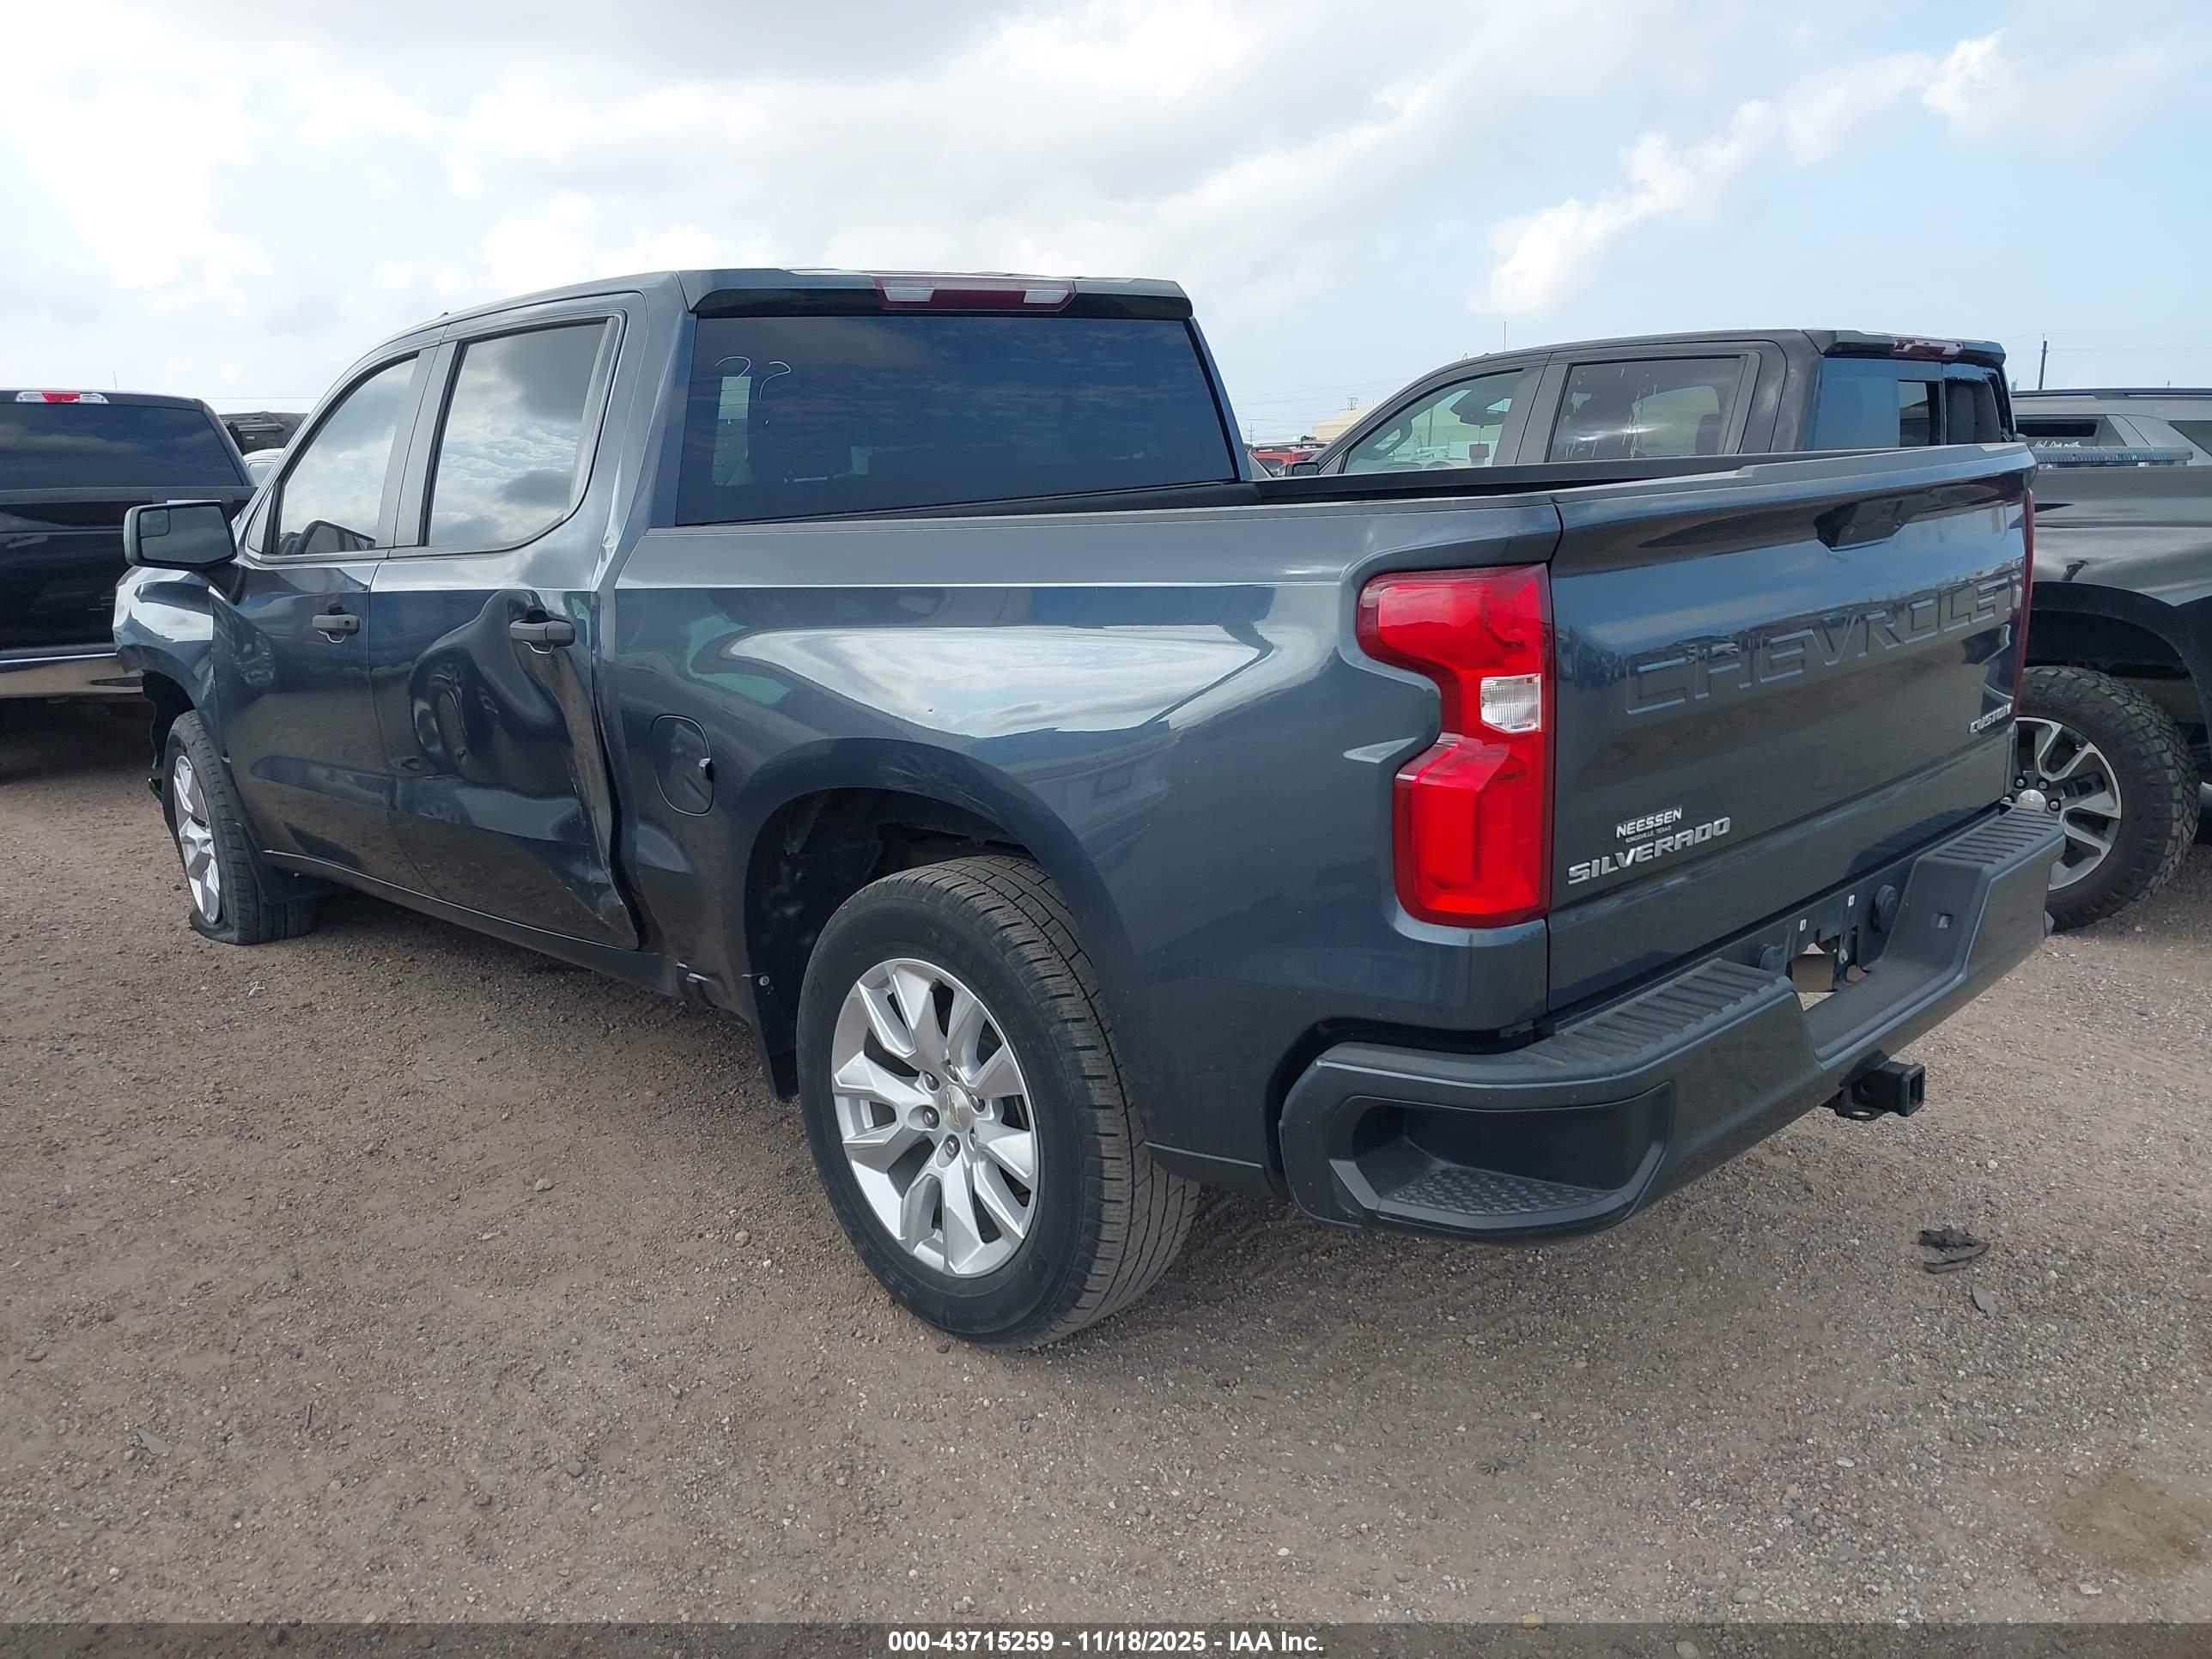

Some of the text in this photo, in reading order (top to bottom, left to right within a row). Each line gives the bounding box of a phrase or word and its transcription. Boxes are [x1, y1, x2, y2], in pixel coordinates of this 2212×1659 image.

[1626, 567, 2023, 714] CHEVROLET
[1568, 817, 1730, 885] SILVERADO
[1616, 807, 1682, 839] NEESSEN
